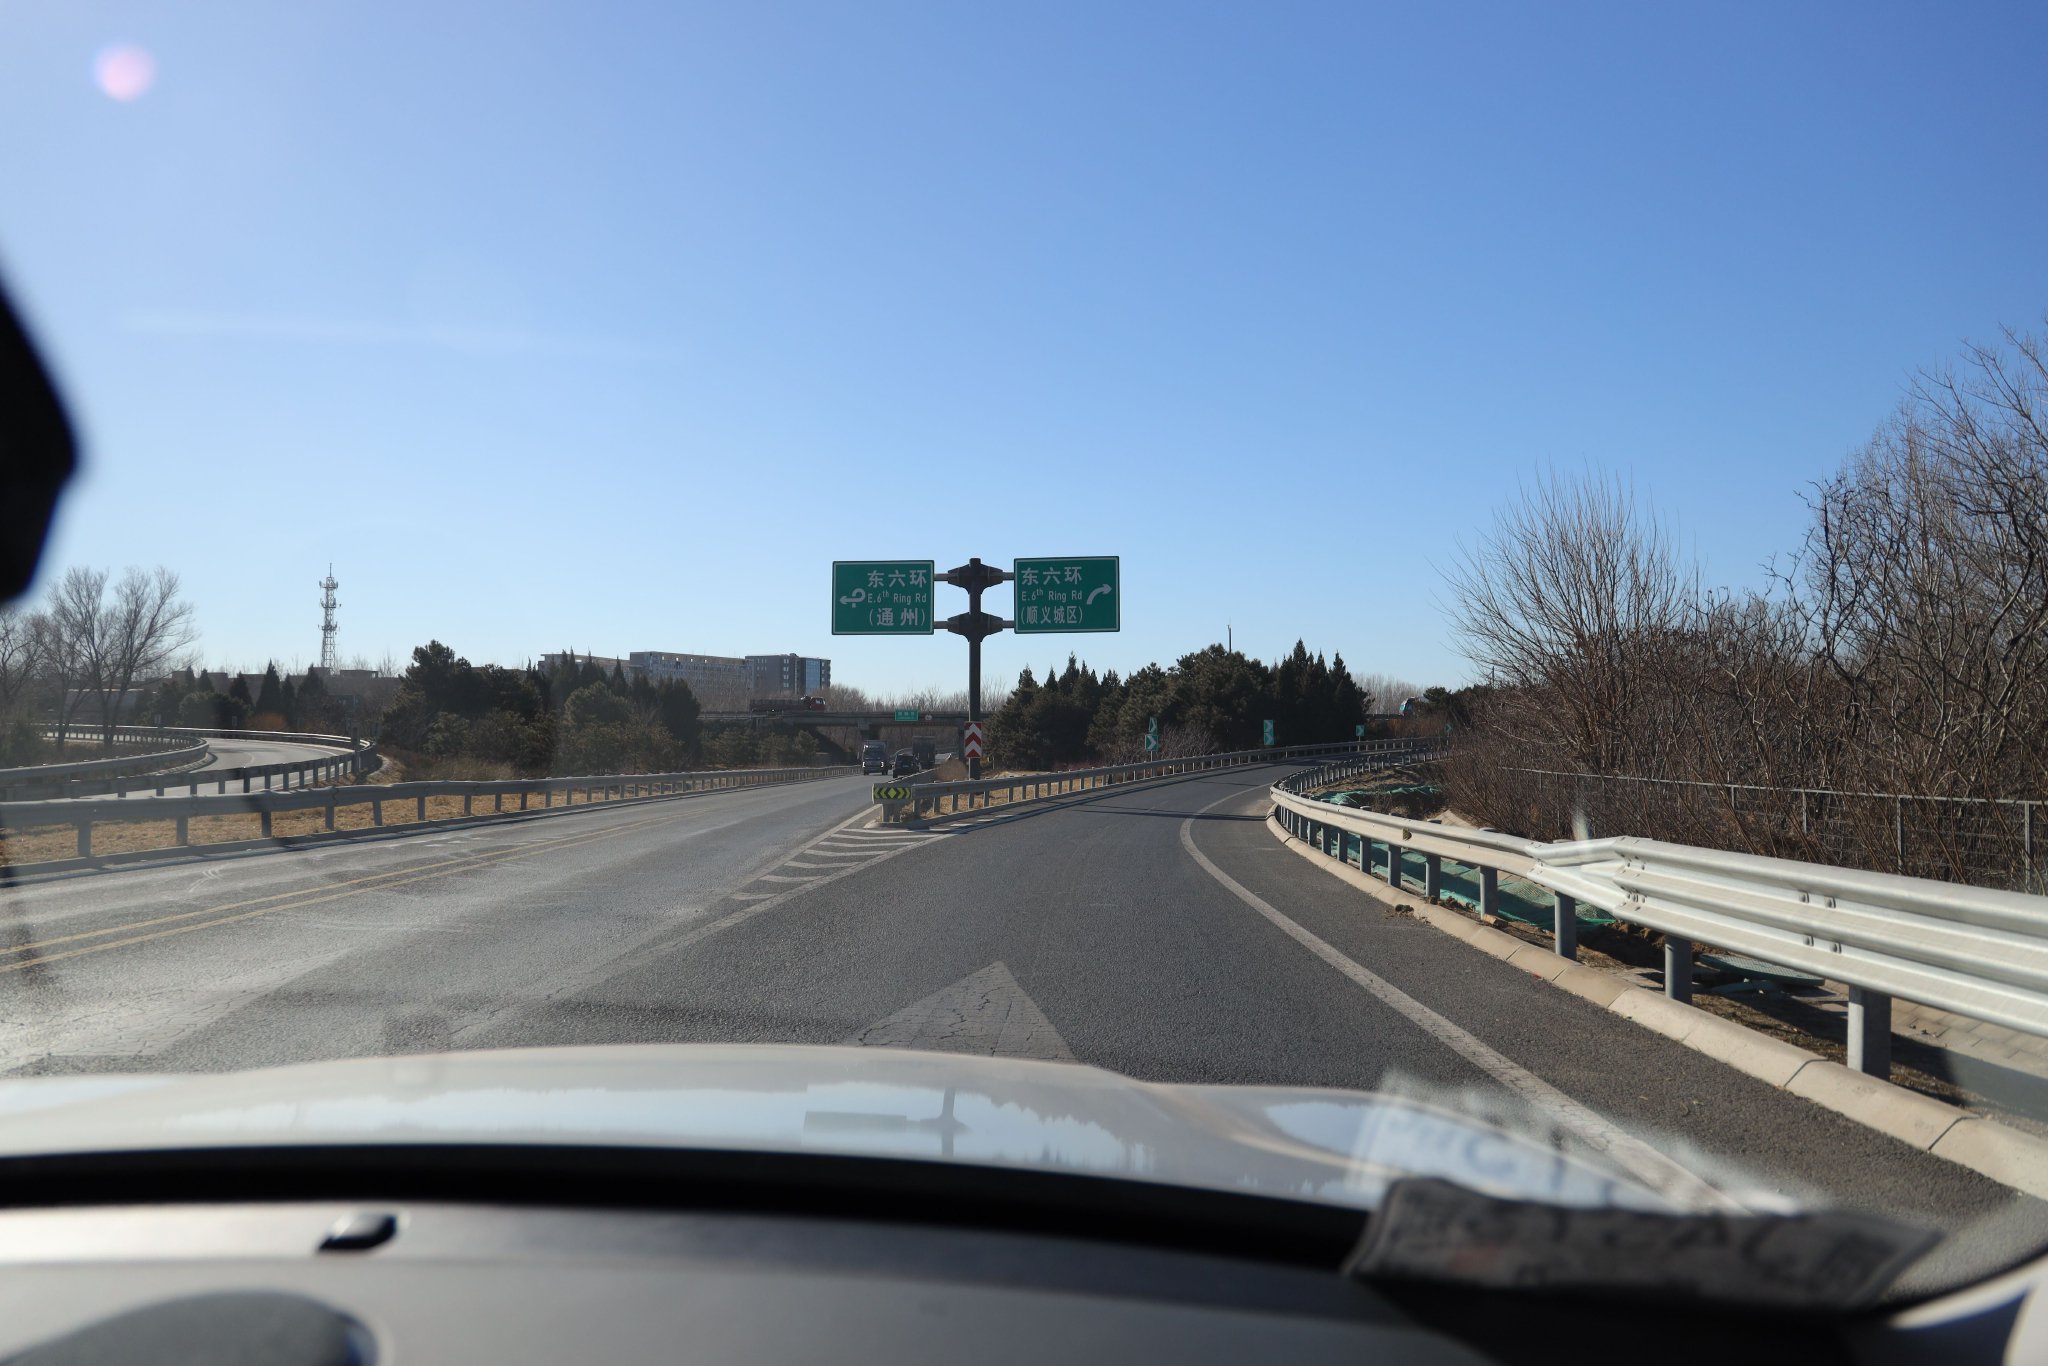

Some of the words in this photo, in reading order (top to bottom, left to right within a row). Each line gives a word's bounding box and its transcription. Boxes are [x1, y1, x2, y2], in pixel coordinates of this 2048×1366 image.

[867, 570, 927, 588] 东六环
[1021, 566, 1082, 585] 东六环
[893, 593, 912, 605] Ring
[915, 593, 927, 603] Rd
[1048, 590, 1067, 603] Ring
[1071, 590, 1082, 600] Rd
